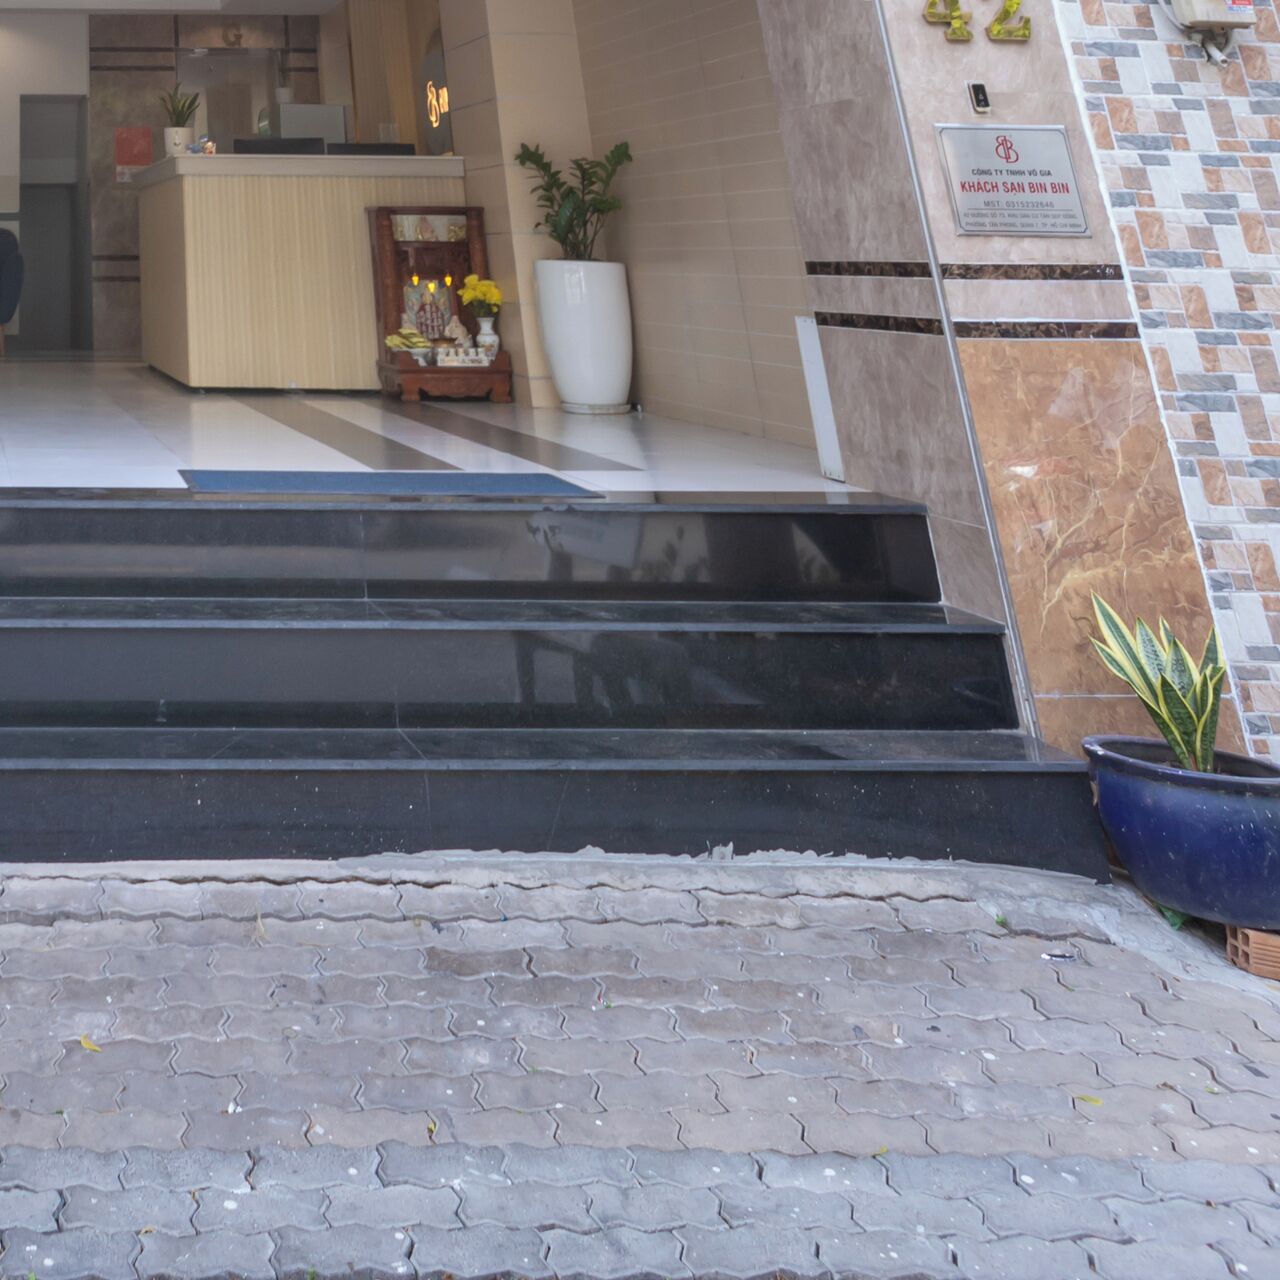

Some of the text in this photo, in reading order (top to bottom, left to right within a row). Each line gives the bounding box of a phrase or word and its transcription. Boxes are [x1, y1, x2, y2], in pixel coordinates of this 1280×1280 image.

[960, 178, 1070, 196] KHÁCH SẠN BIN BIN
